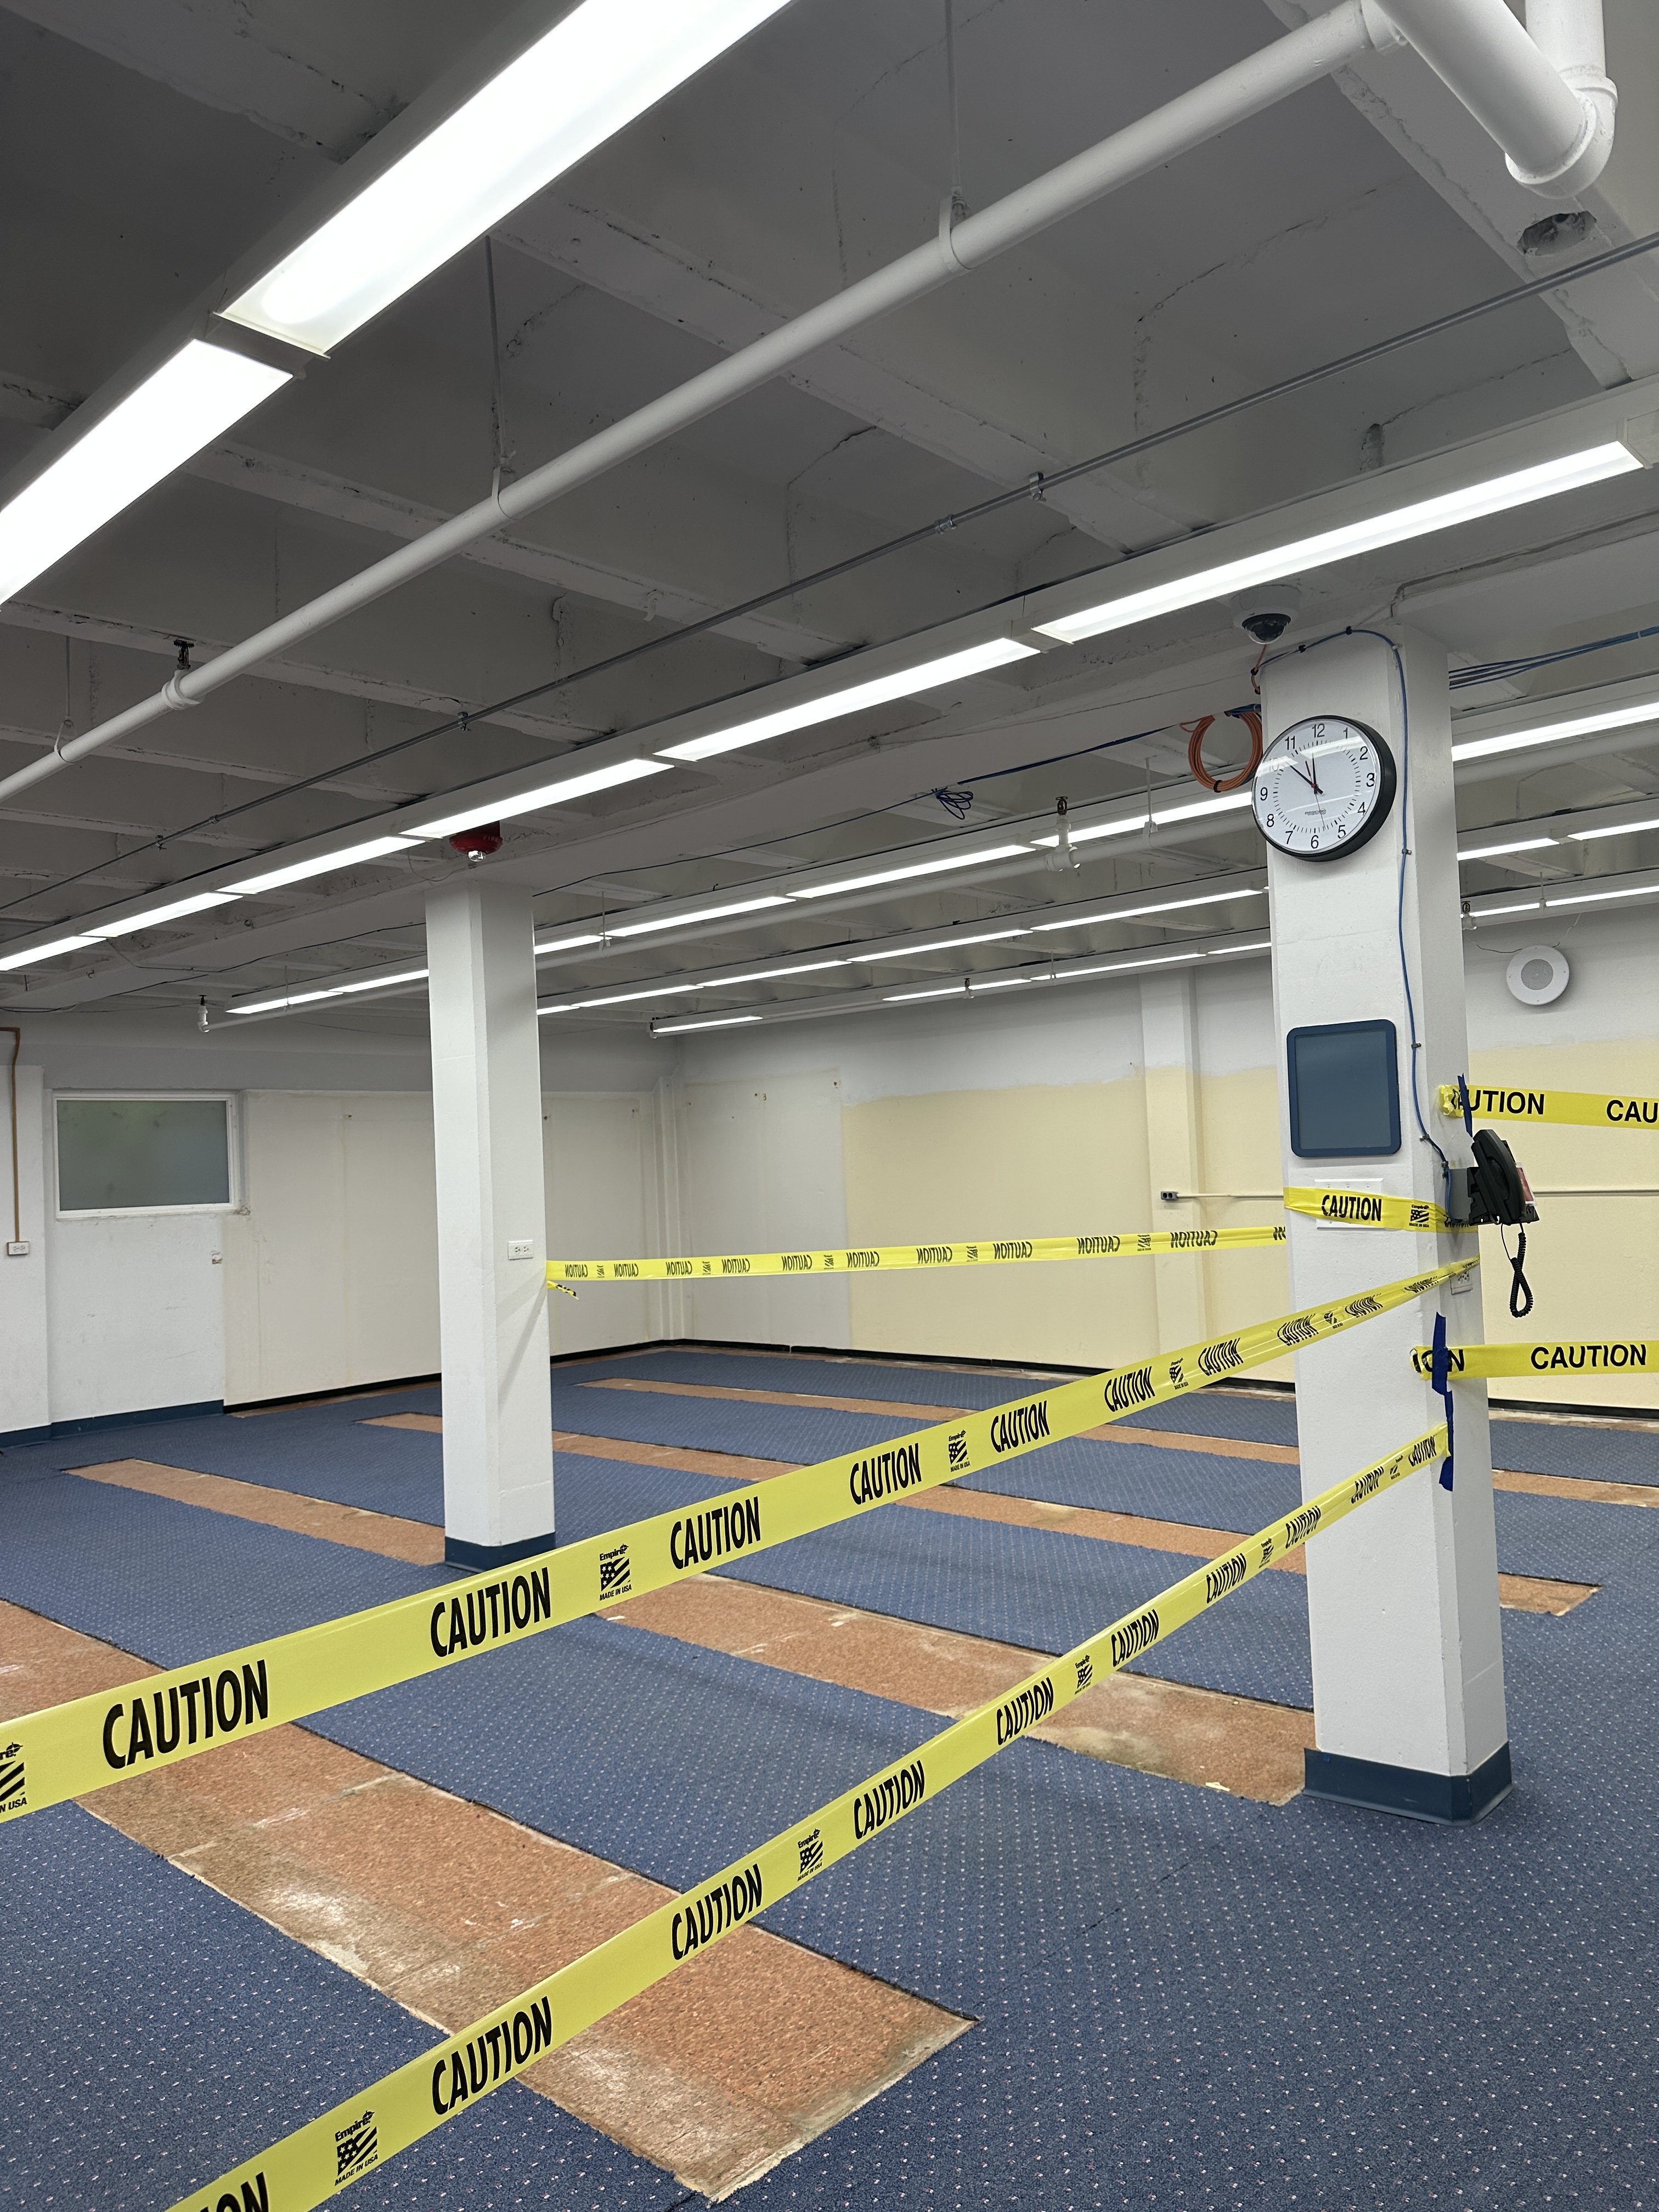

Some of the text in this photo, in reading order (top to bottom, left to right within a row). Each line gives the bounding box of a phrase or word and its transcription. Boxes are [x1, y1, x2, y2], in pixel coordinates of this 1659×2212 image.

[1284, 735, 1295, 750] 11
[1312, 723, 1325, 738] 12
[1342, 727, 1348, 739] 1
[1359, 746, 1368, 760] 2
[1366, 772, 1375, 787] 3
[1260, 787, 1268, 801] 9
[1266, 813, 1274, 827] 8
[1357, 802, 1366, 816] 4
[1285, 830, 1294, 844] 7
[1311, 834, 1319, 849] 6
[1337, 824, 1346, 839] 5
[1321, 1194, 1382, 1222] CAUTION
[1277, 1313, 1319, 1346] CAUTION
[1198, 1337, 1244, 1376] CAUTION
[1531, 1344, 1646, 1370] CAUTION
[1104, 1365, 1155, 1412] CAUTION
[990, 1401, 1050, 1453] CAUTION
[850, 1443, 922, 1505] CAUTION
[670, 1496, 761, 1570] CAUTION
[1285, 1505, 1322, 1549] CAUTION
[599, 1548, 624, 1561] Empire
[1206, 1553, 1247, 1604] CAUTION
[599, 1584, 632, 1601] MADE IN USA
[430, 1566, 551, 1657] CAUTION
[1111, 1609, 1159, 1667] CAUTION
[103, 1659, 269, 1769] CAUTION
[996, 1677, 1054, 1746] CAUTION
[8, 1797, 27, 1810] USA
[853, 1760, 925, 1839] CAUTION
[797, 1833, 818, 1848] Empire
[672, 1863, 763, 1960] CAUTION
[432, 1996, 552, 2115] CAUTION
[335, 2118, 368, 2142] Empire
[335, 2154, 378, 2186] MADE IN USA
